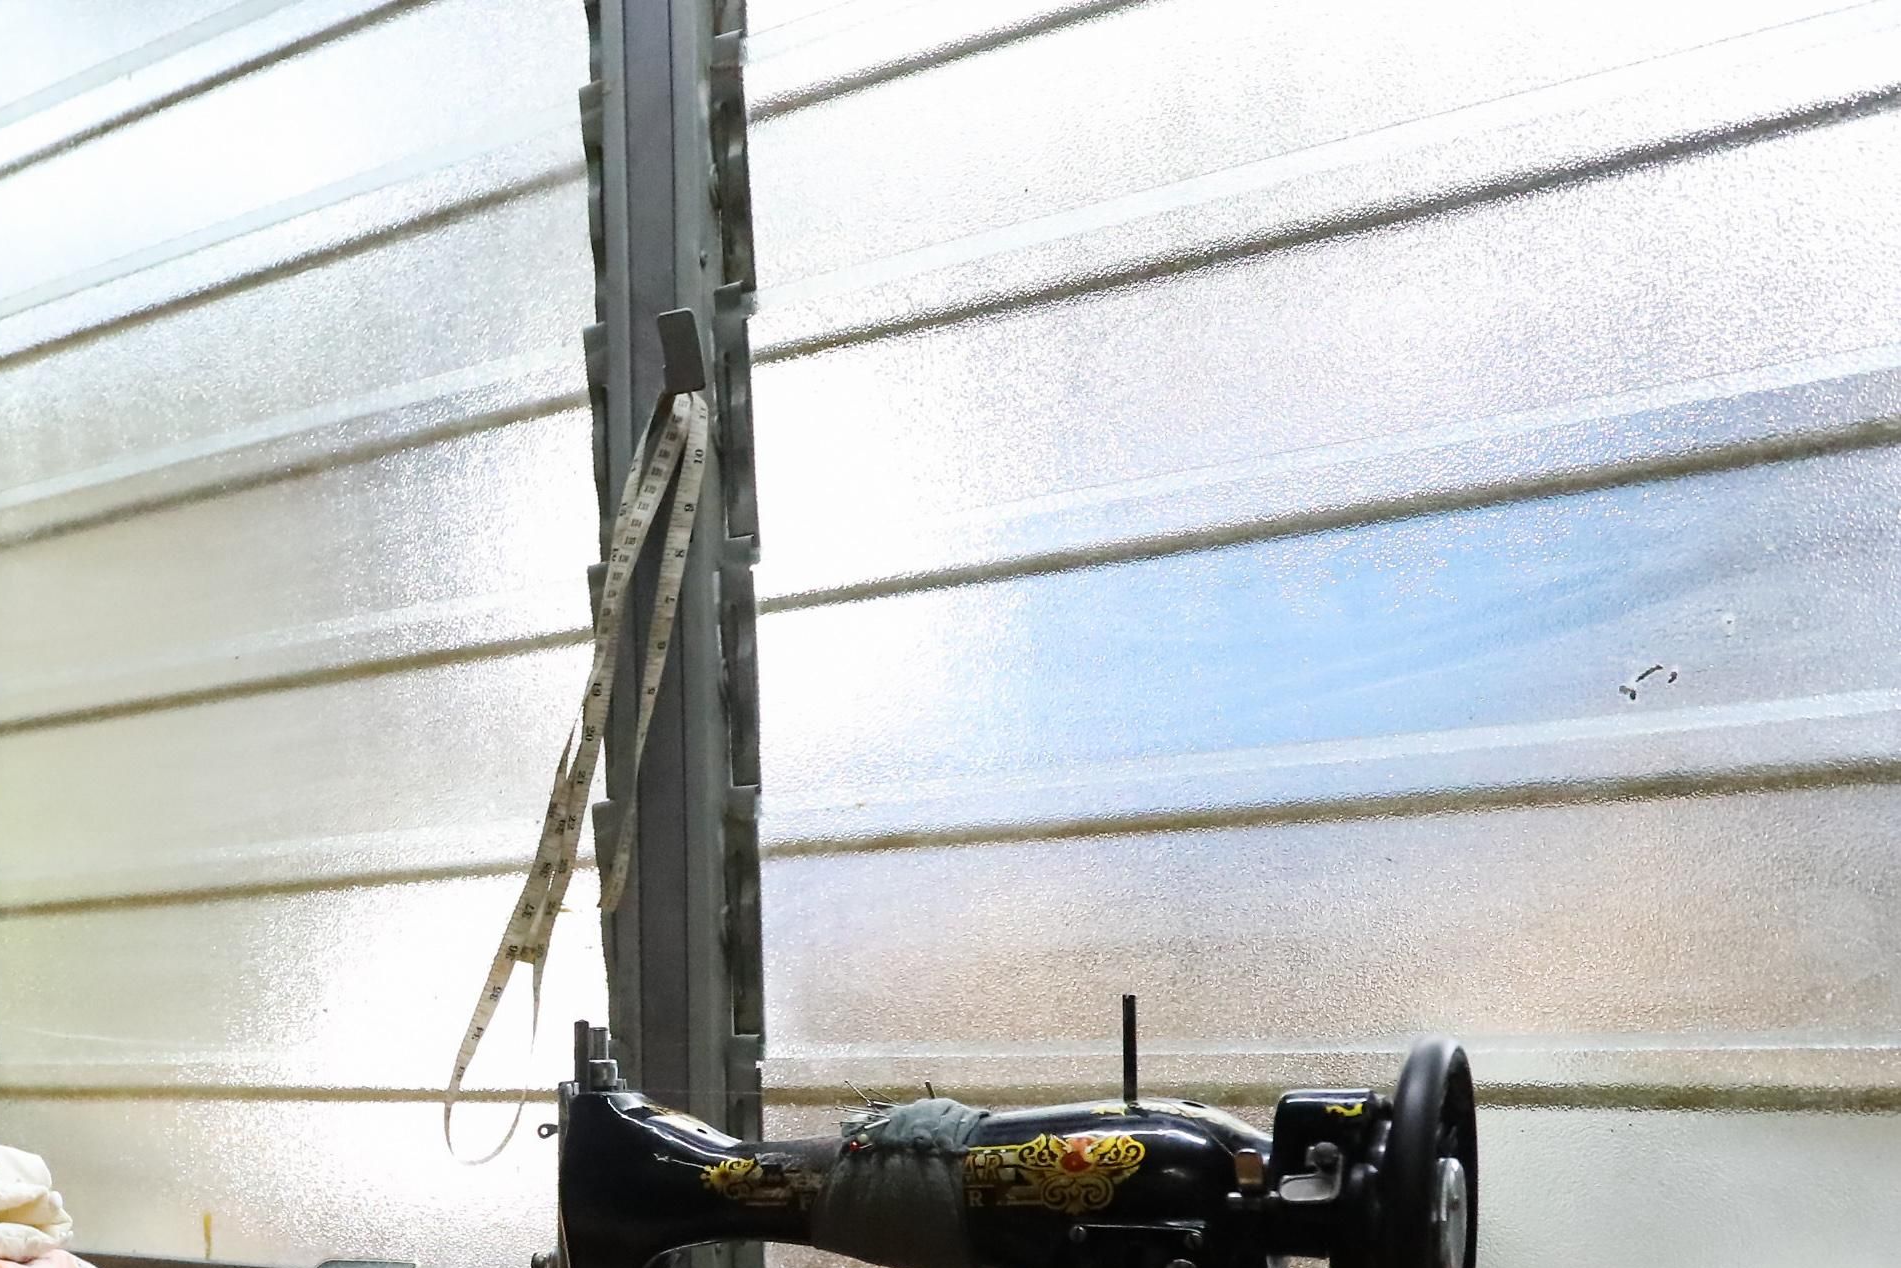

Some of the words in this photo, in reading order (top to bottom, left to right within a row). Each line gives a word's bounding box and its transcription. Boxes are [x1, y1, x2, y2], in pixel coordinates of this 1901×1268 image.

[693, 448, 704, 465] 10
[683, 503, 695, 512] 9
[675, 549, 686, 558] 8
[664, 595, 675, 604] 7
[585, 725, 596, 742] 20
[576, 770, 587, 785] 21
[566, 815, 577, 831] 22
[488, 985, 503, 1002] 35
[521, 903, 535, 920] 37
